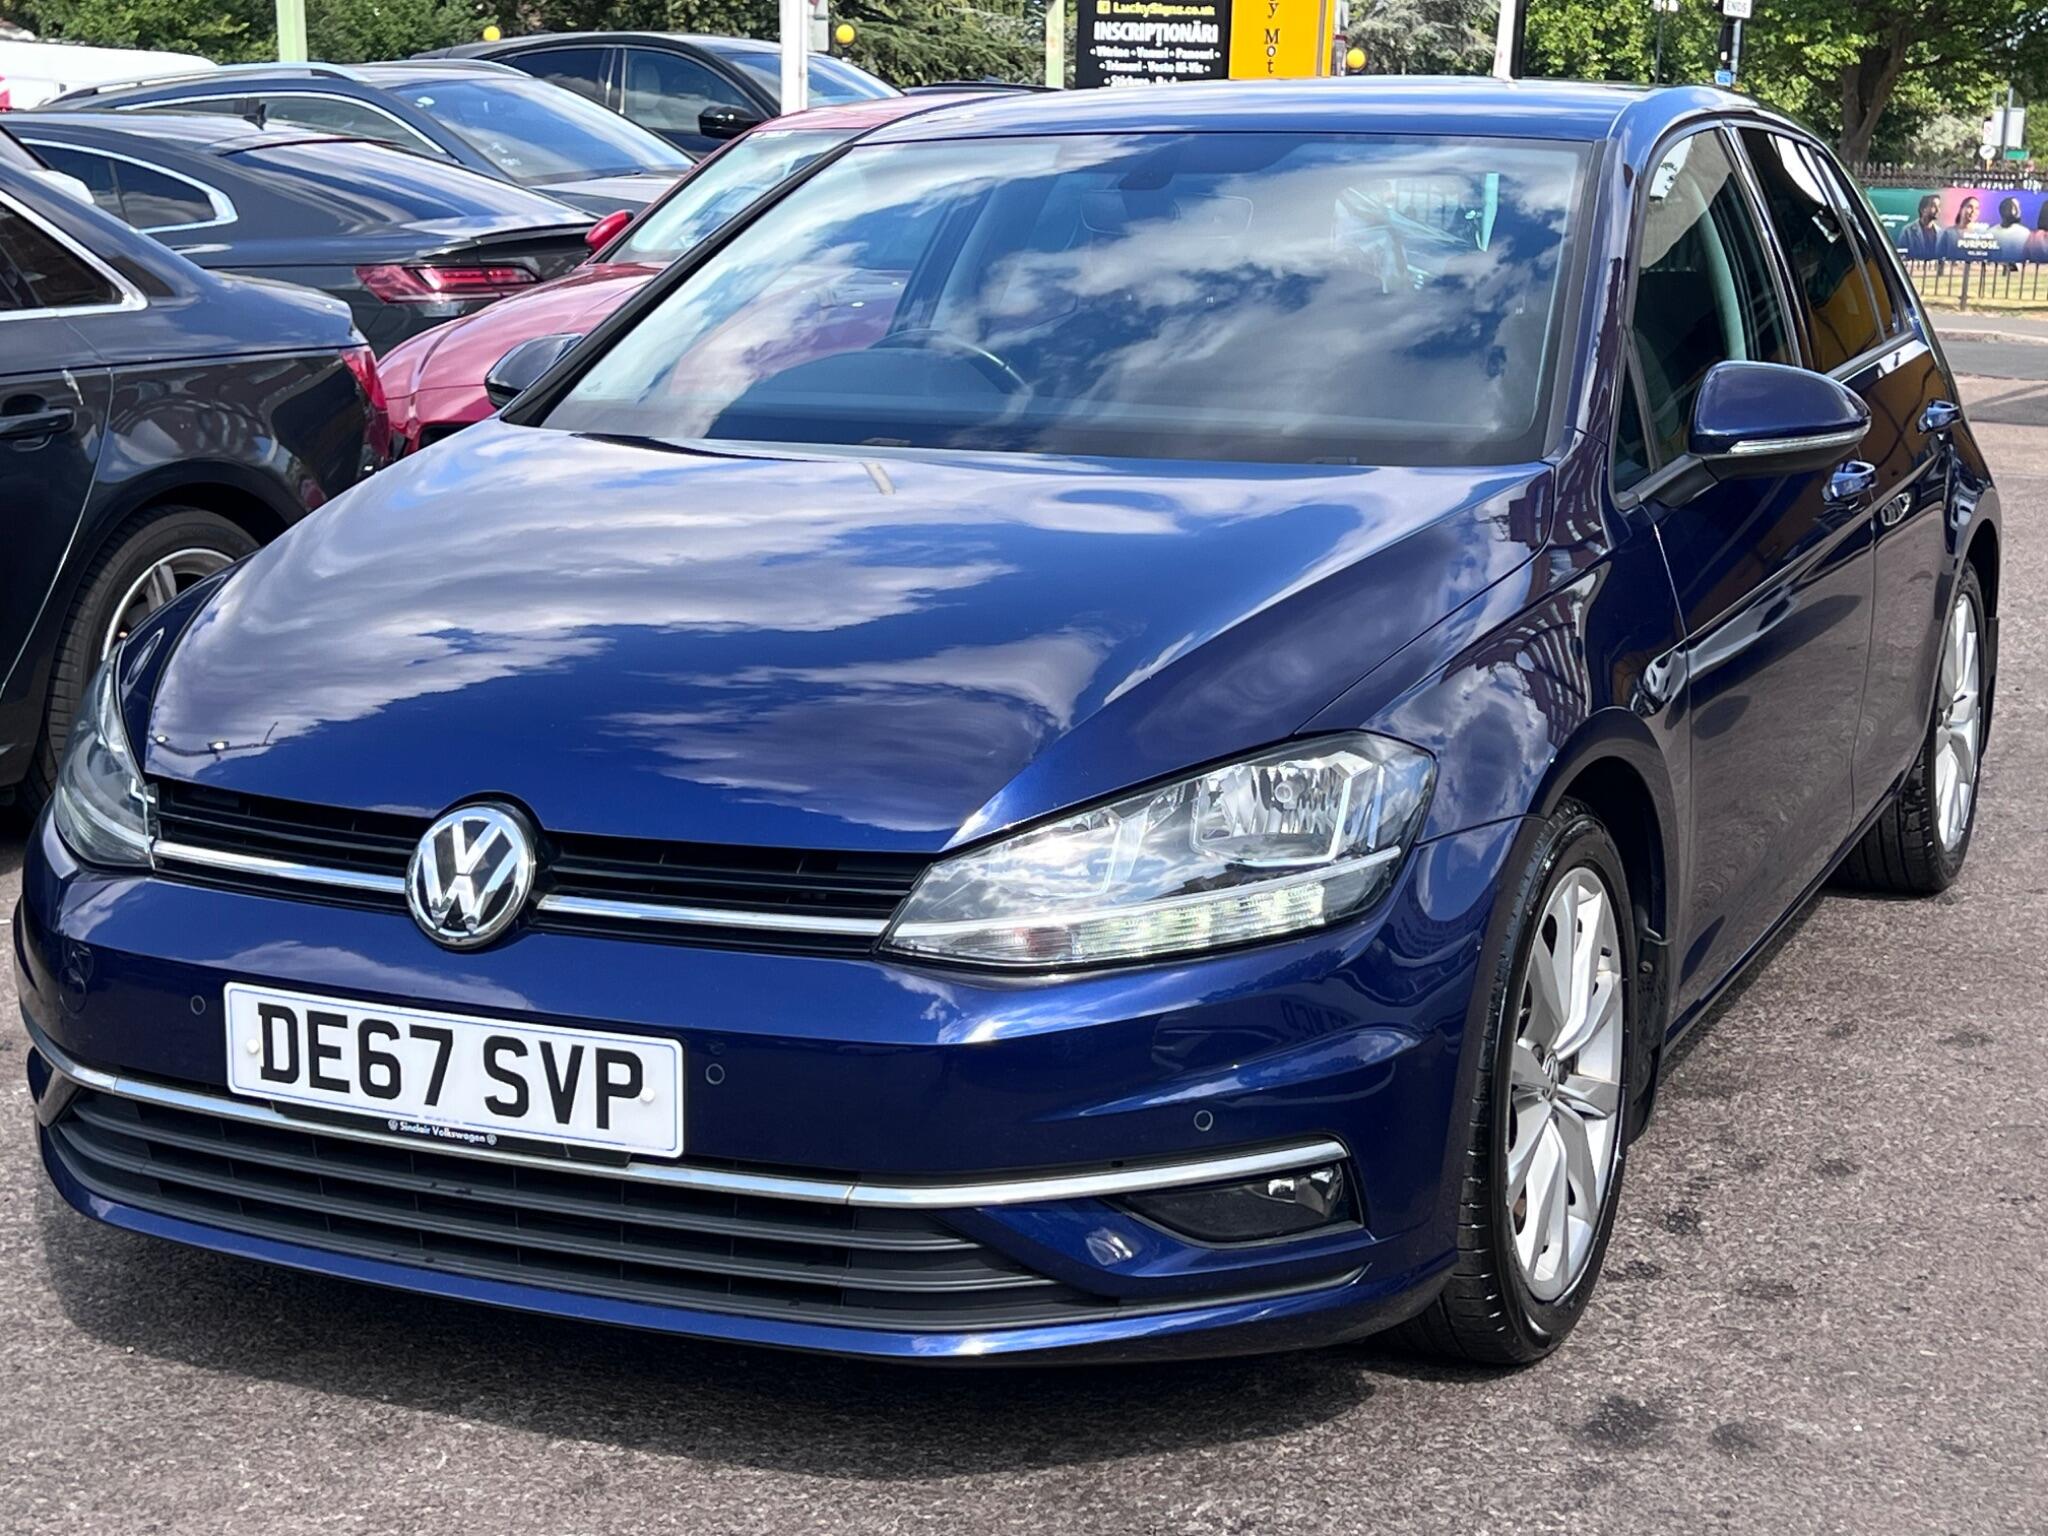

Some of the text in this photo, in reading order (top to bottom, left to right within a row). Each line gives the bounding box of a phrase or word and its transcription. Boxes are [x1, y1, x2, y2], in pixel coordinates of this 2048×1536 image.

[258, 1002, 644, 1130] DE67 SVP
[399, 1121, 486, 1143] Sinclair Volkswagen
